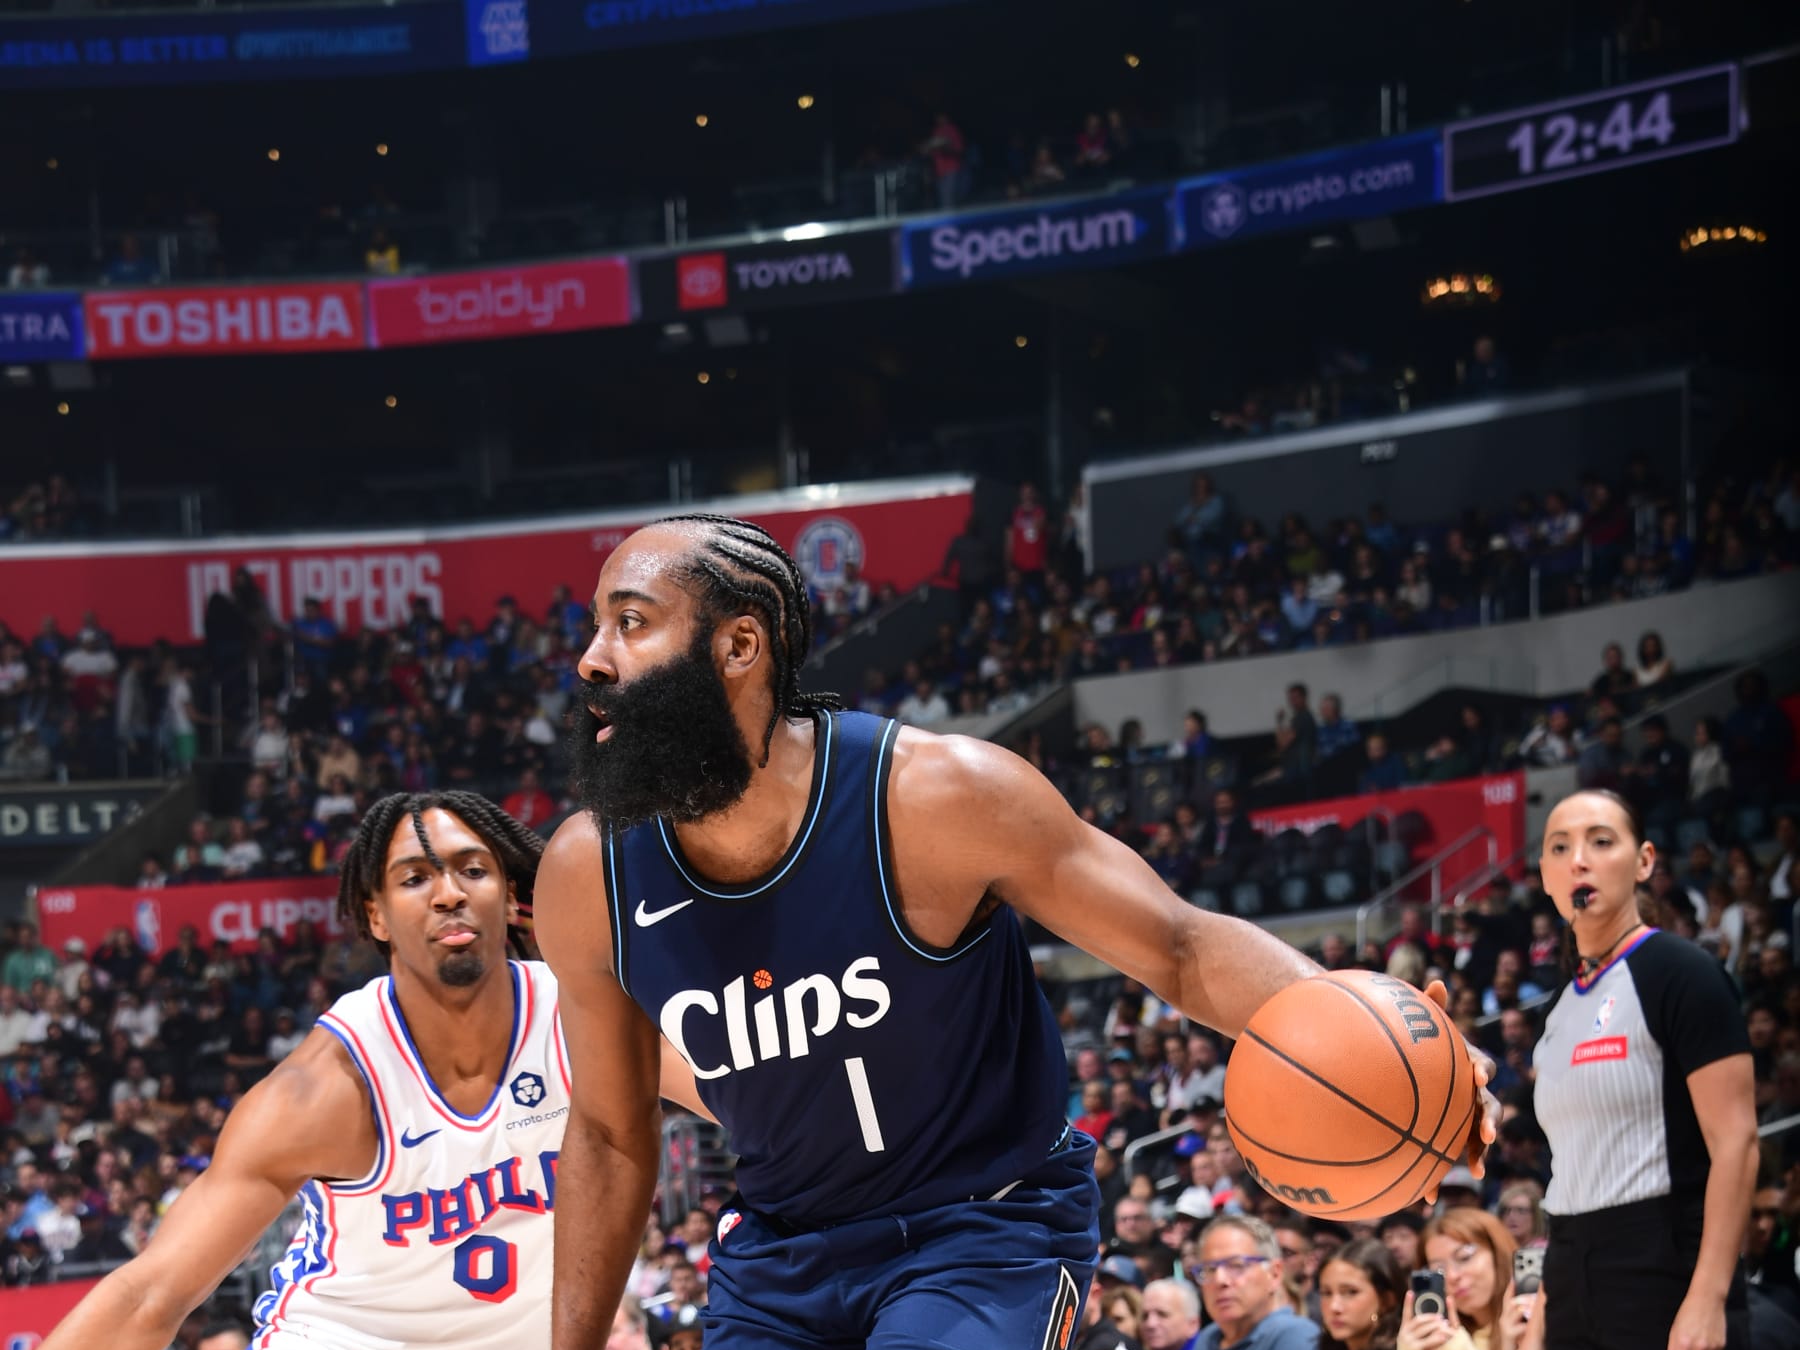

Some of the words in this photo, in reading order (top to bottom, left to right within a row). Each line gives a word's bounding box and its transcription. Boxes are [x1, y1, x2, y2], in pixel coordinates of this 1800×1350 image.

[120, 34, 229, 63] BETTER
[1507, 91, 1676, 174] 12:44
[1248, 158, 1414, 215] crypto.com
[930, 208, 1136, 277] Spectrum
[416, 273, 586, 327] boldyn
[735, 253, 853, 290] TOYOTA
[98, 295, 353, 348] TOSHIBA
[660, 956, 891, 1080] Clips
[505, 1106, 569, 1131] crypto.com
[844, 1057, 885, 1153] 1
[453, 1234, 517, 1304] 0
